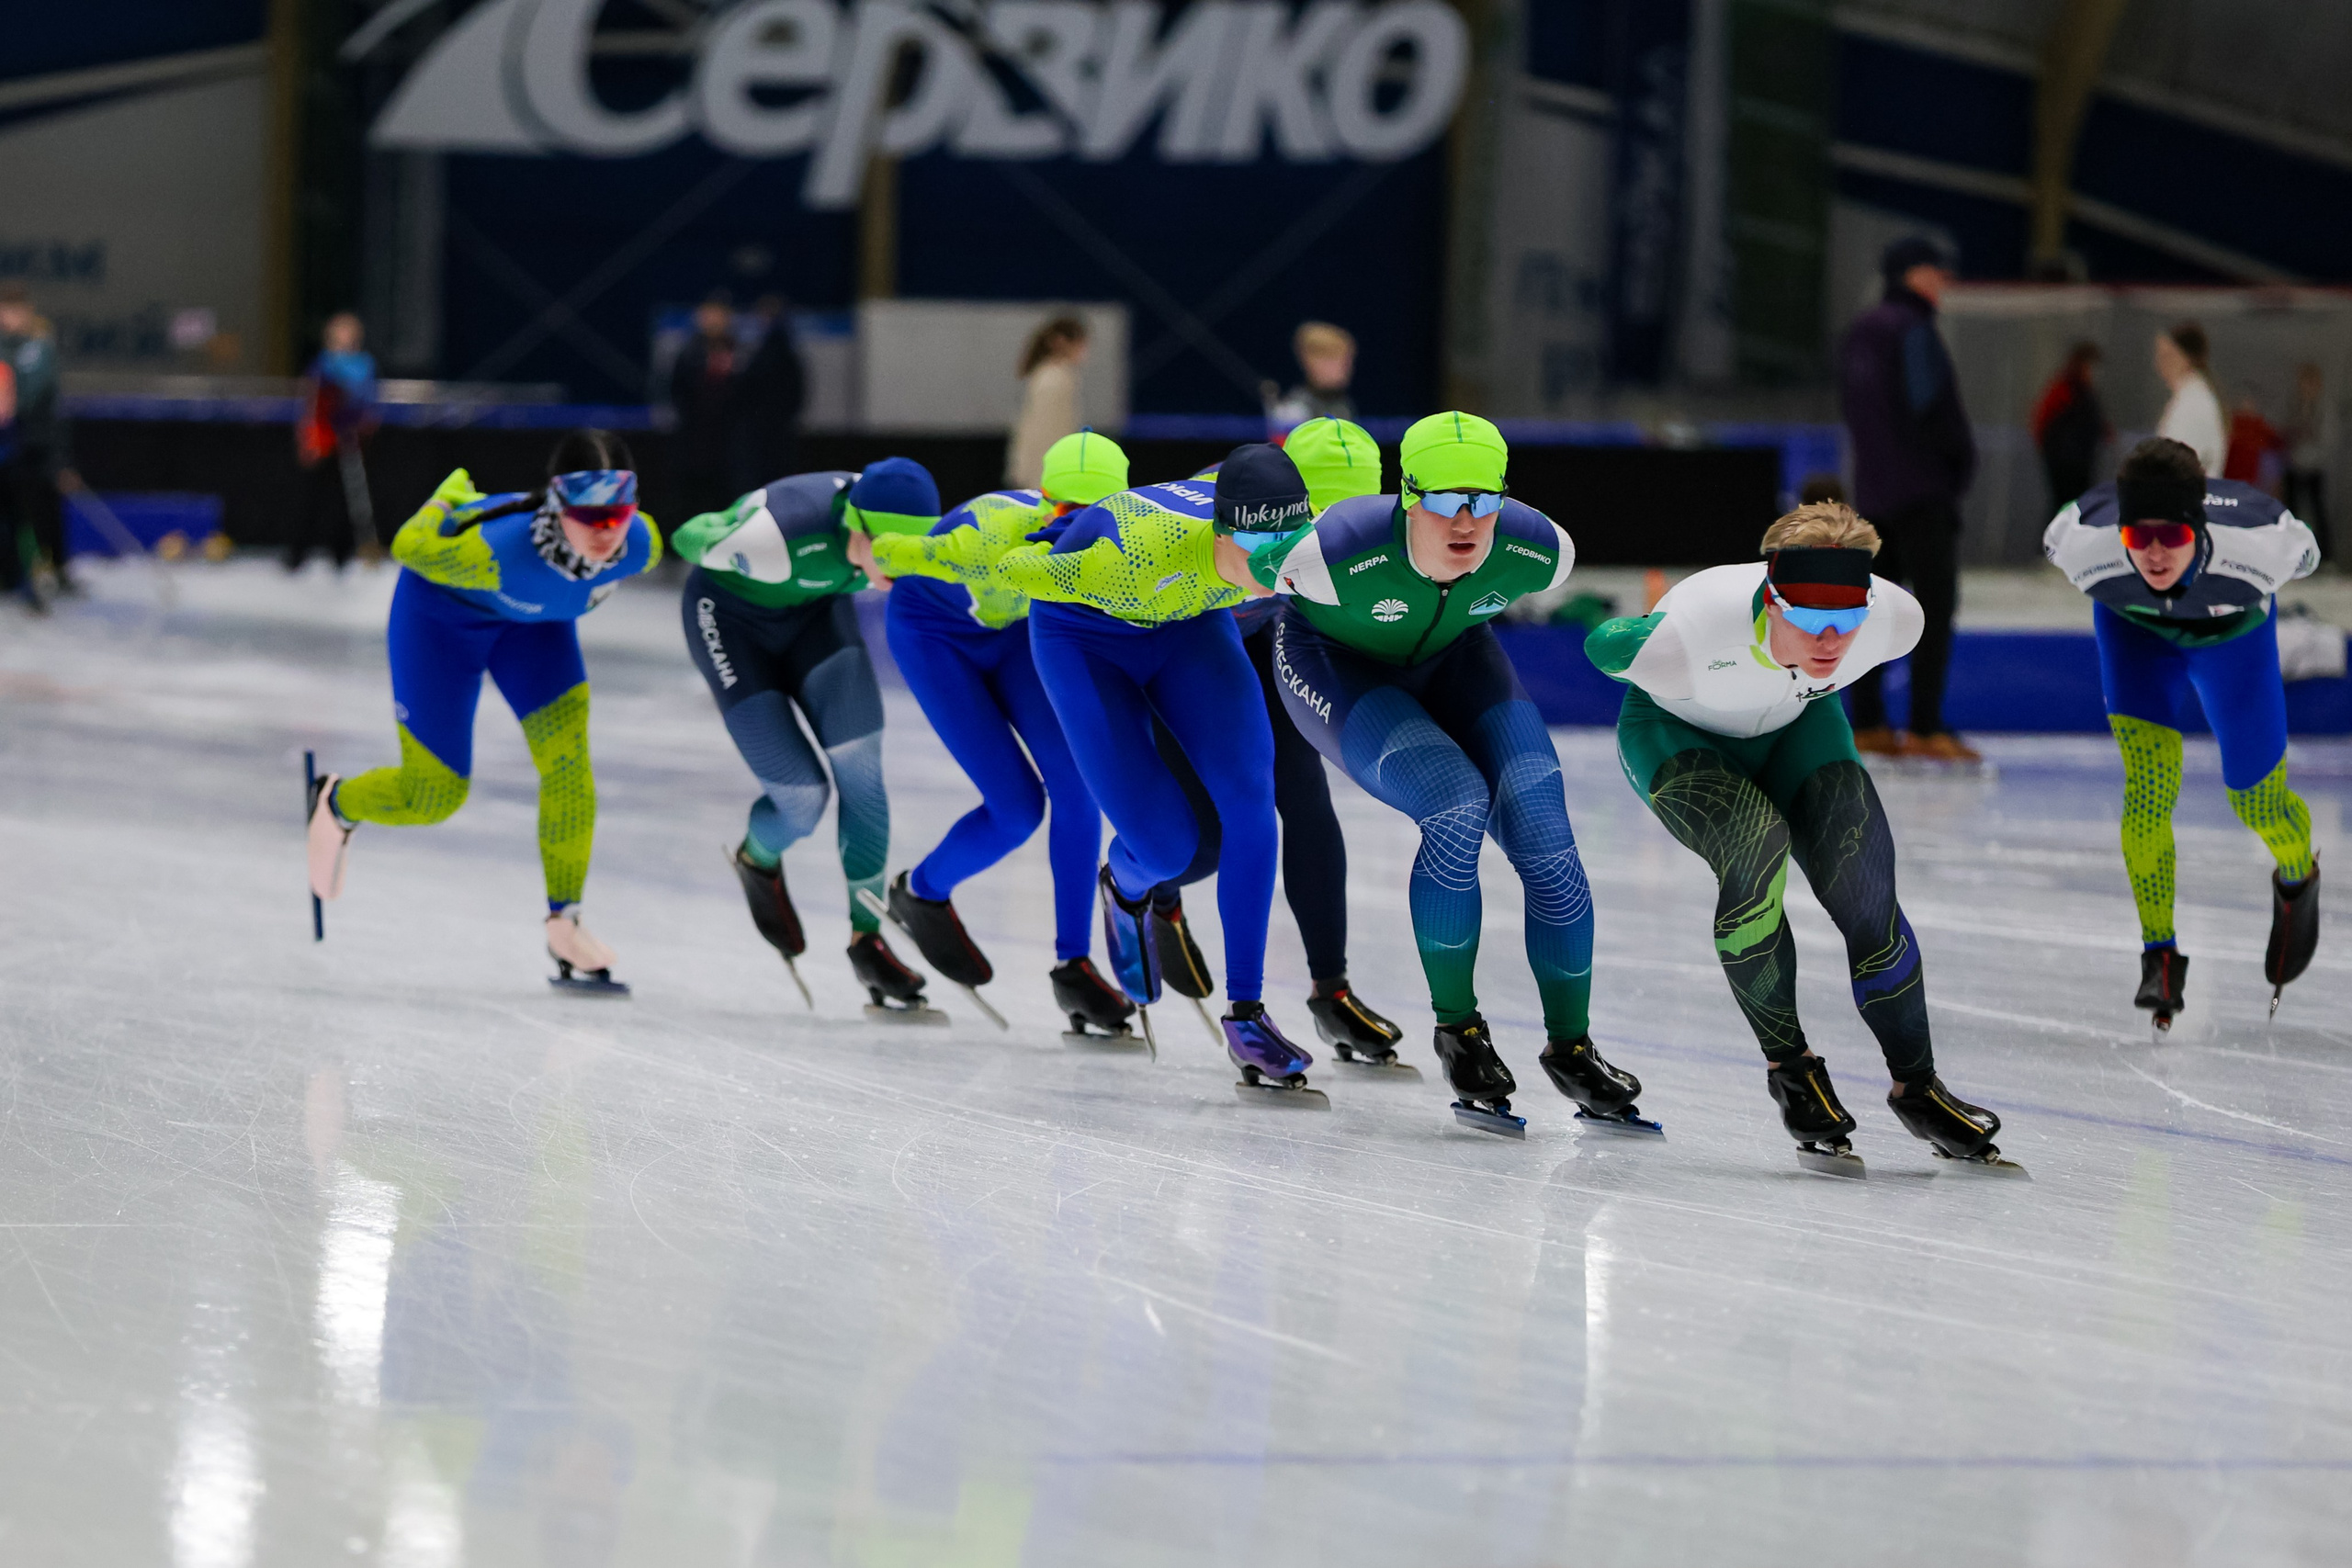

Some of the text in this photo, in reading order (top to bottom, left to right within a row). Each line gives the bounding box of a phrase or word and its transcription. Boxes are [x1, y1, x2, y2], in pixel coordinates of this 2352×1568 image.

[496, 0, 1470, 208] Сервико
[1349, 554, 1388, 575] NERPA
[1708, 660, 1737, 671] FORMA
